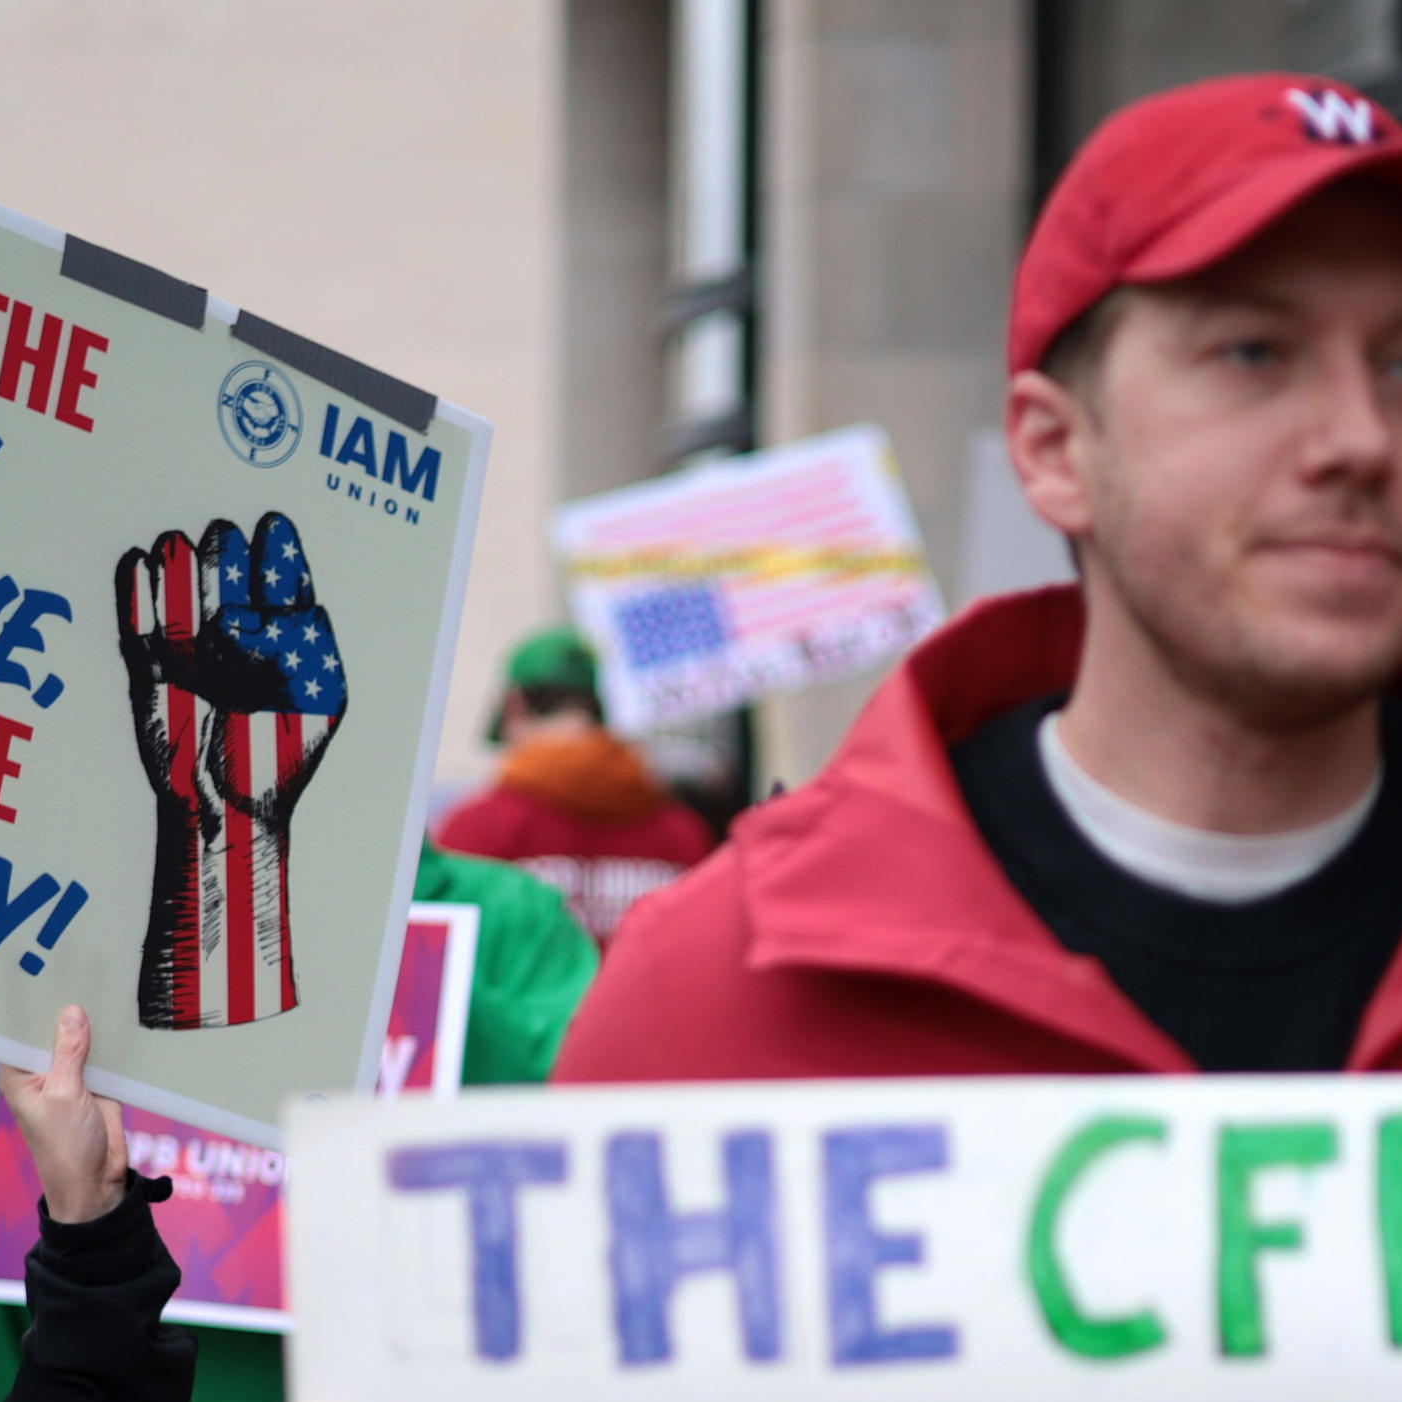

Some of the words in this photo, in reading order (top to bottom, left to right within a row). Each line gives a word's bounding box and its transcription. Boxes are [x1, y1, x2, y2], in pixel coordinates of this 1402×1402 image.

[1283, 86, 1374, 144] W
[319, 403, 441, 503] IAM
[327, 473, 420, 525] UNION
[186, 1138, 284, 1186] UNIO
[386, 1122, 960, 1368] THE
